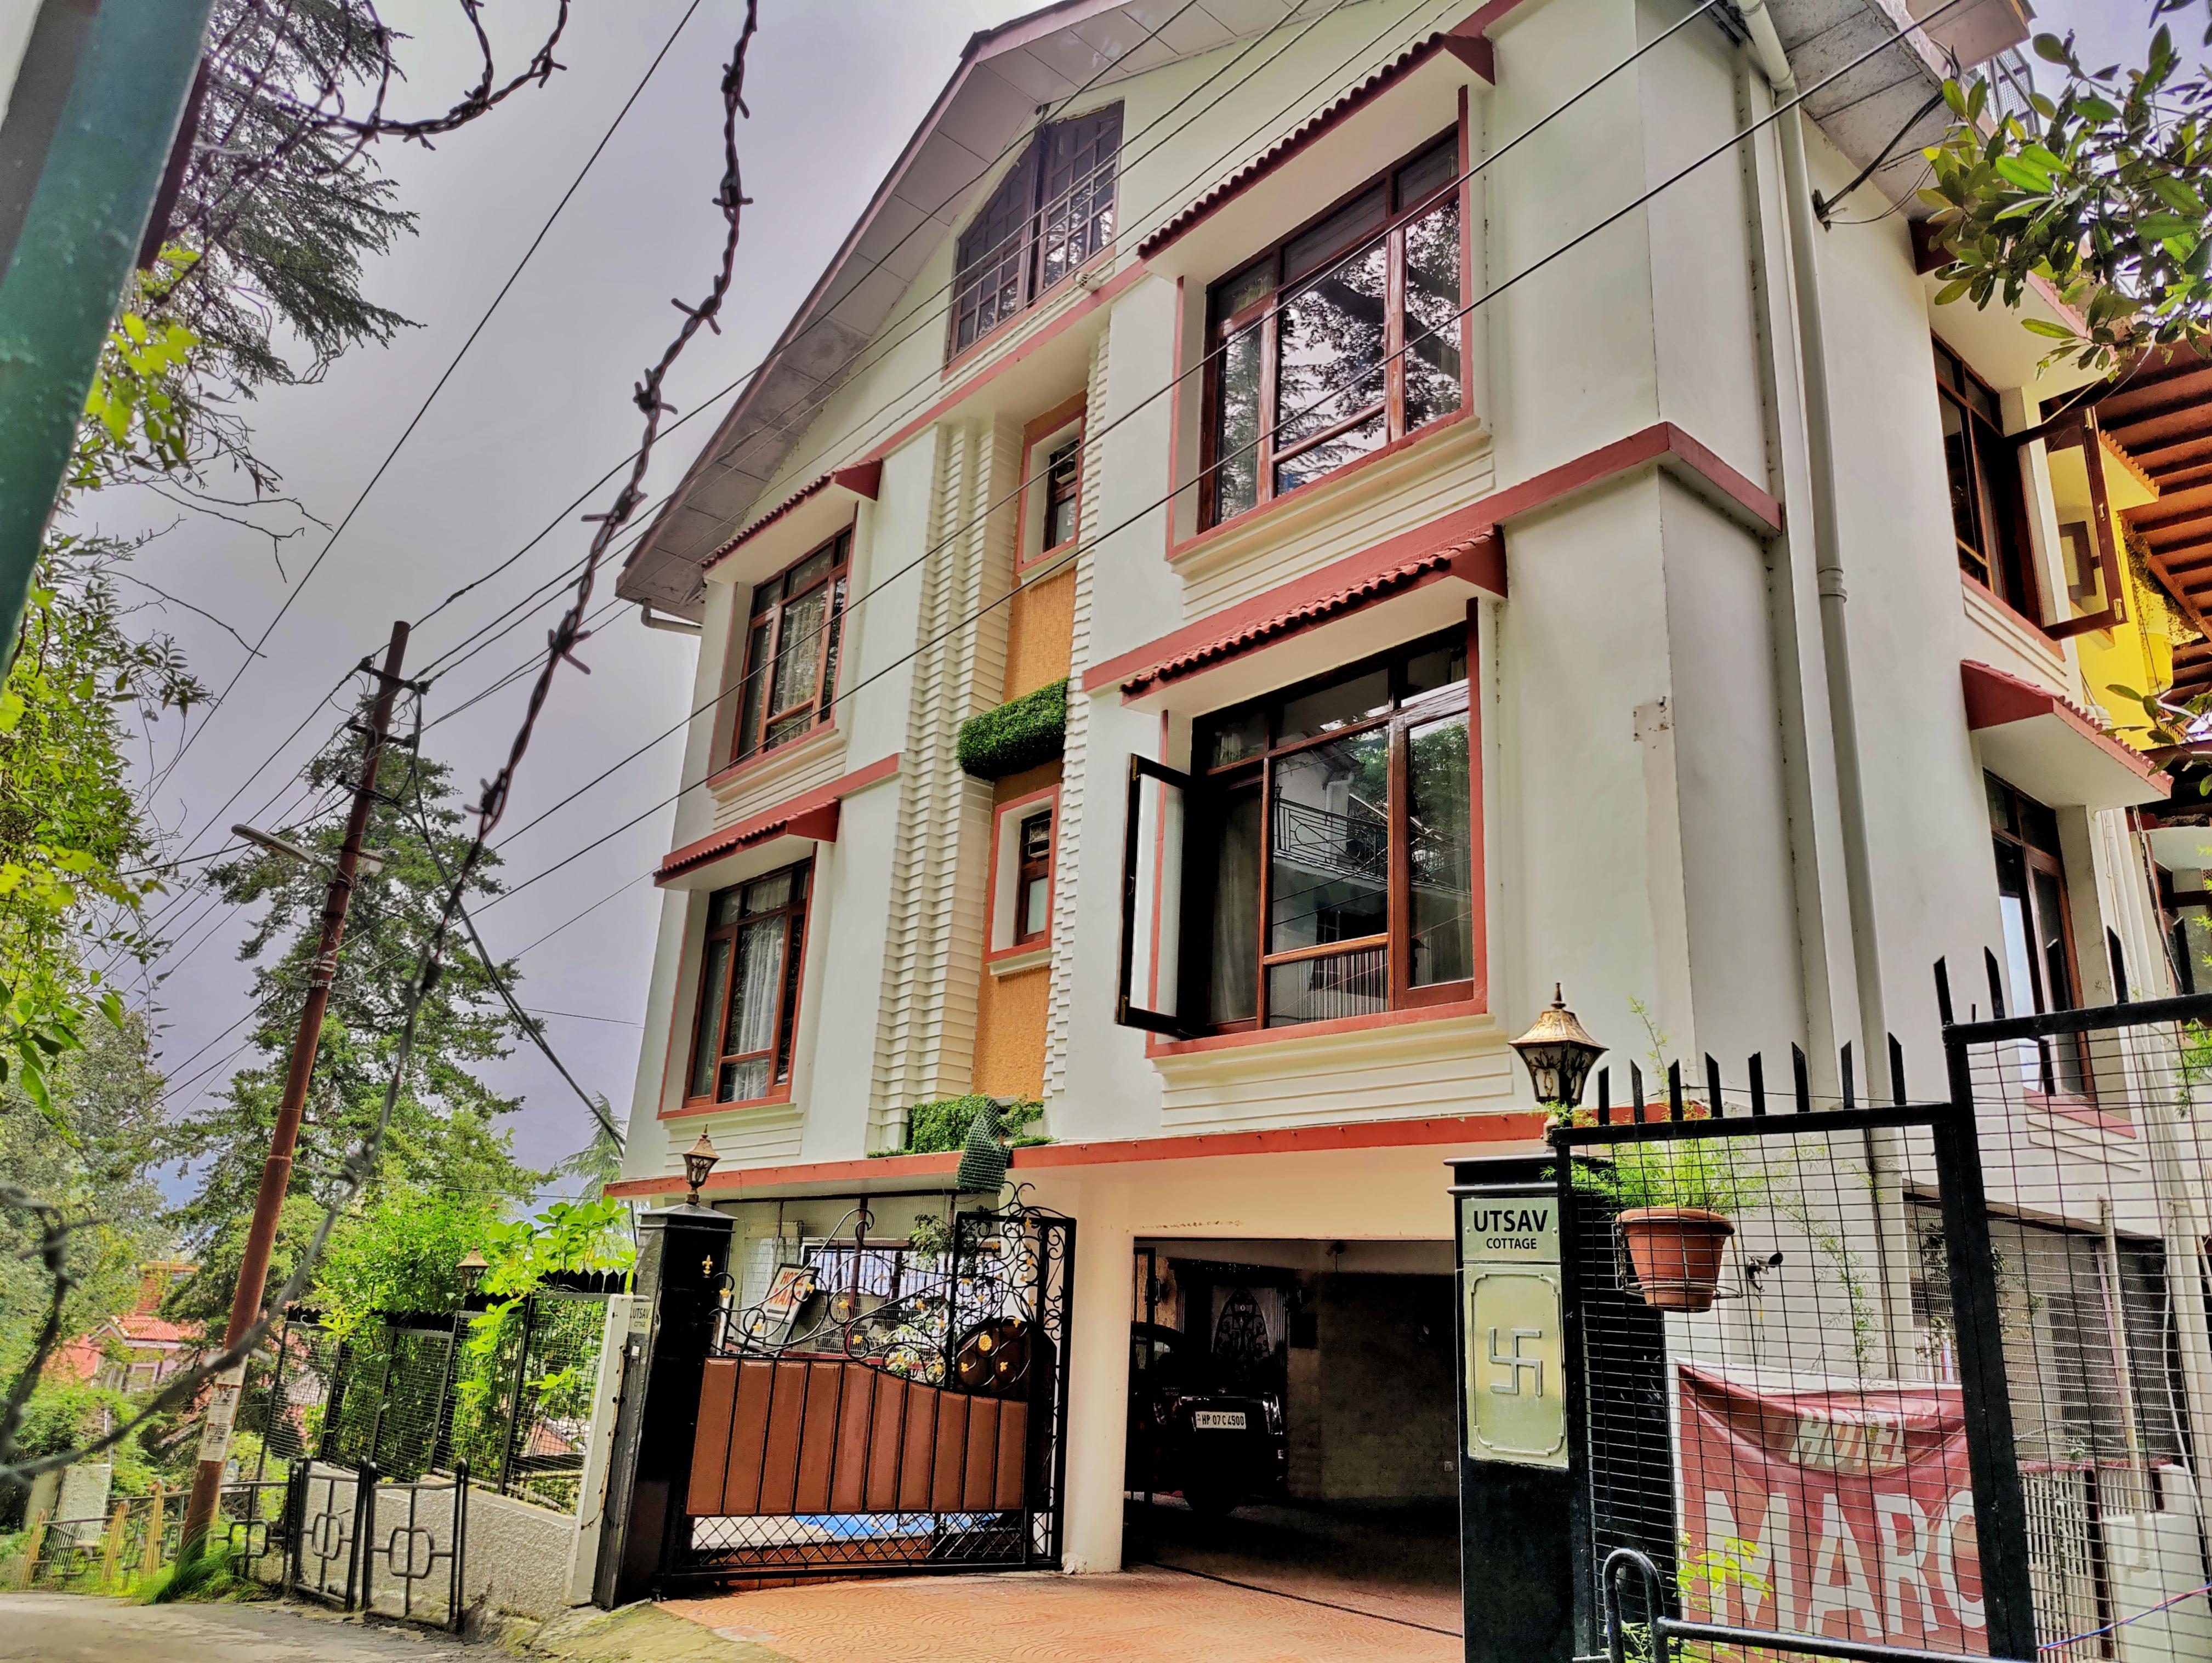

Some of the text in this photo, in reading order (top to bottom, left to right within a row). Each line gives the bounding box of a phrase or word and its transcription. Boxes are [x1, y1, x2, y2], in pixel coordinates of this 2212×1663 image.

[1474, 1210, 1548, 1232] UTSAV
[1486, 1238, 1537, 1249] COTTAGE
[633, 1308, 650, 1319] UTSAV
[1202, 1414, 1244, 1426] HP 07 C 4500
[1789, 1407, 1907, 1467] HOTEL
